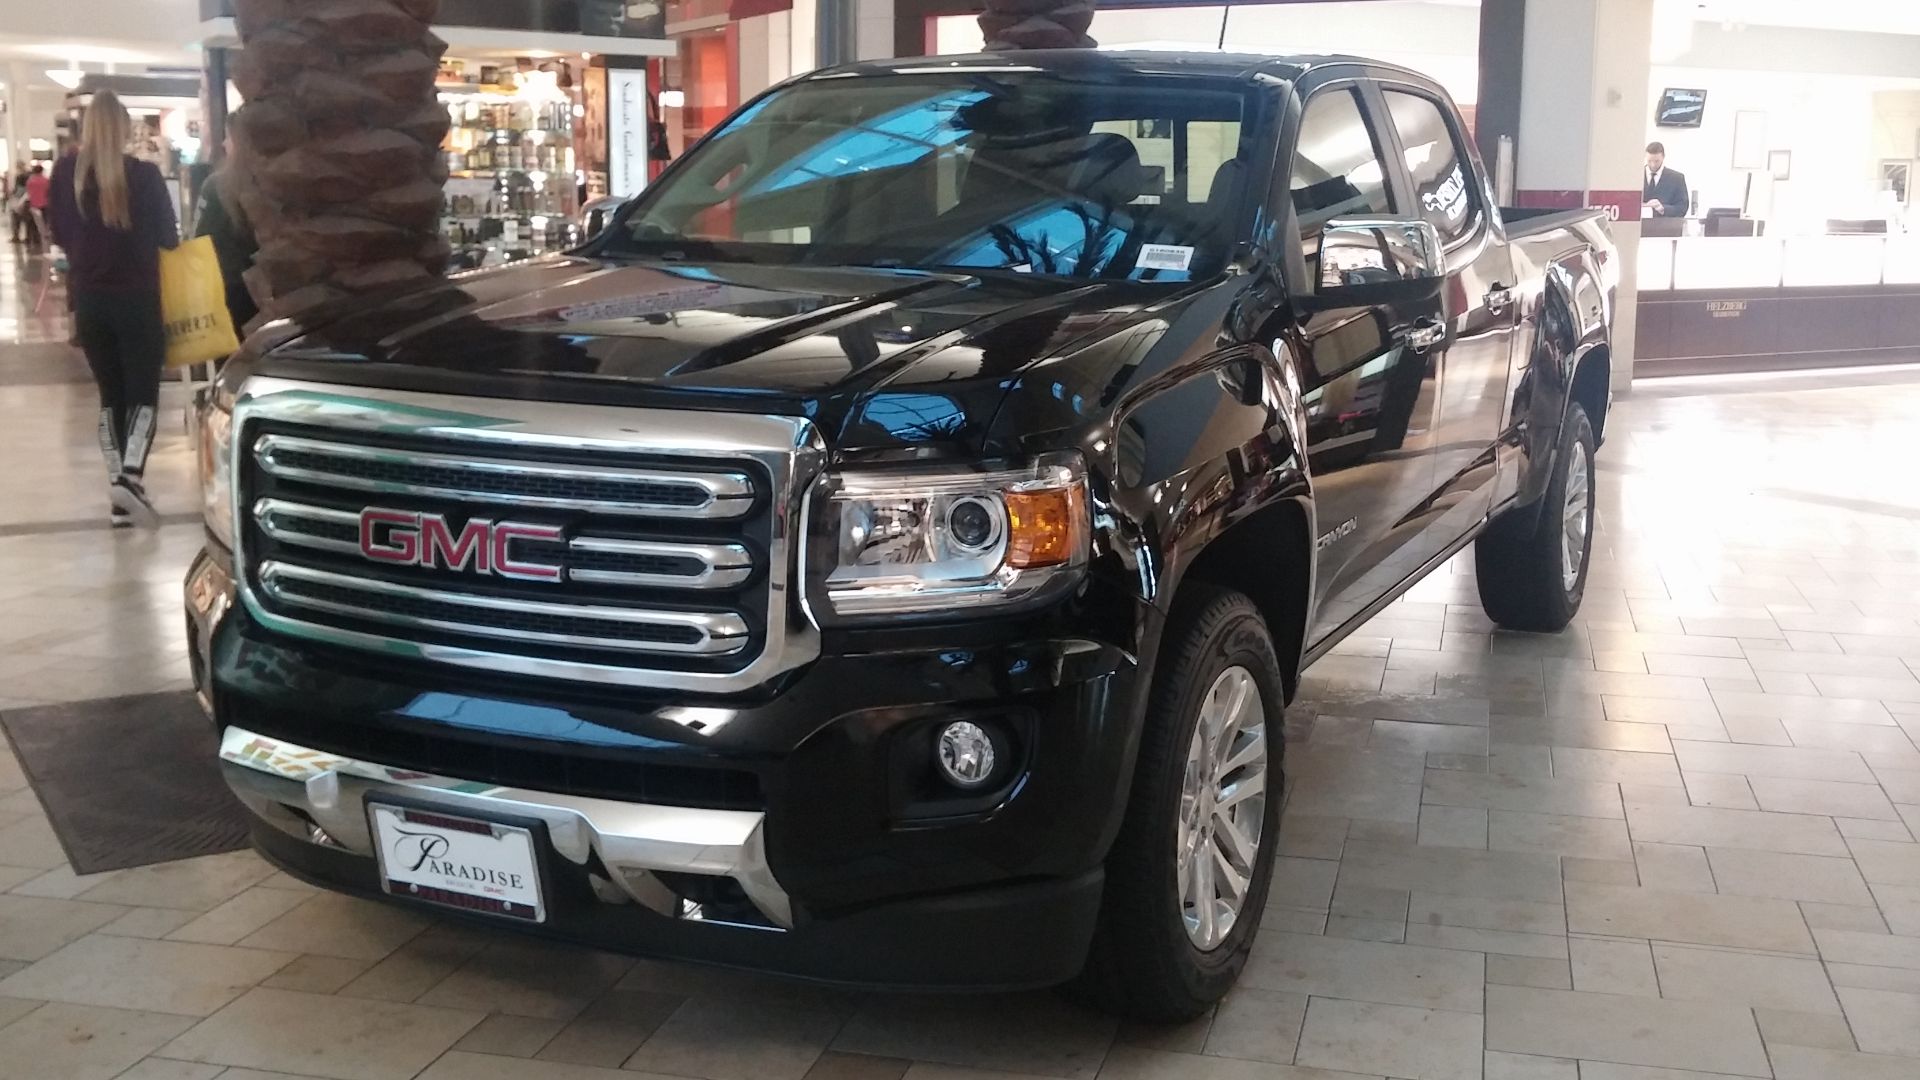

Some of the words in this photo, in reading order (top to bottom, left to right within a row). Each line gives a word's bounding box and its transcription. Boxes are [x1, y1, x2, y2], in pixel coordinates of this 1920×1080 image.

[360, 506, 563, 583] GMC
[1316, 516, 1357, 551] CANYON
[392, 826, 524, 889] PARADISE
